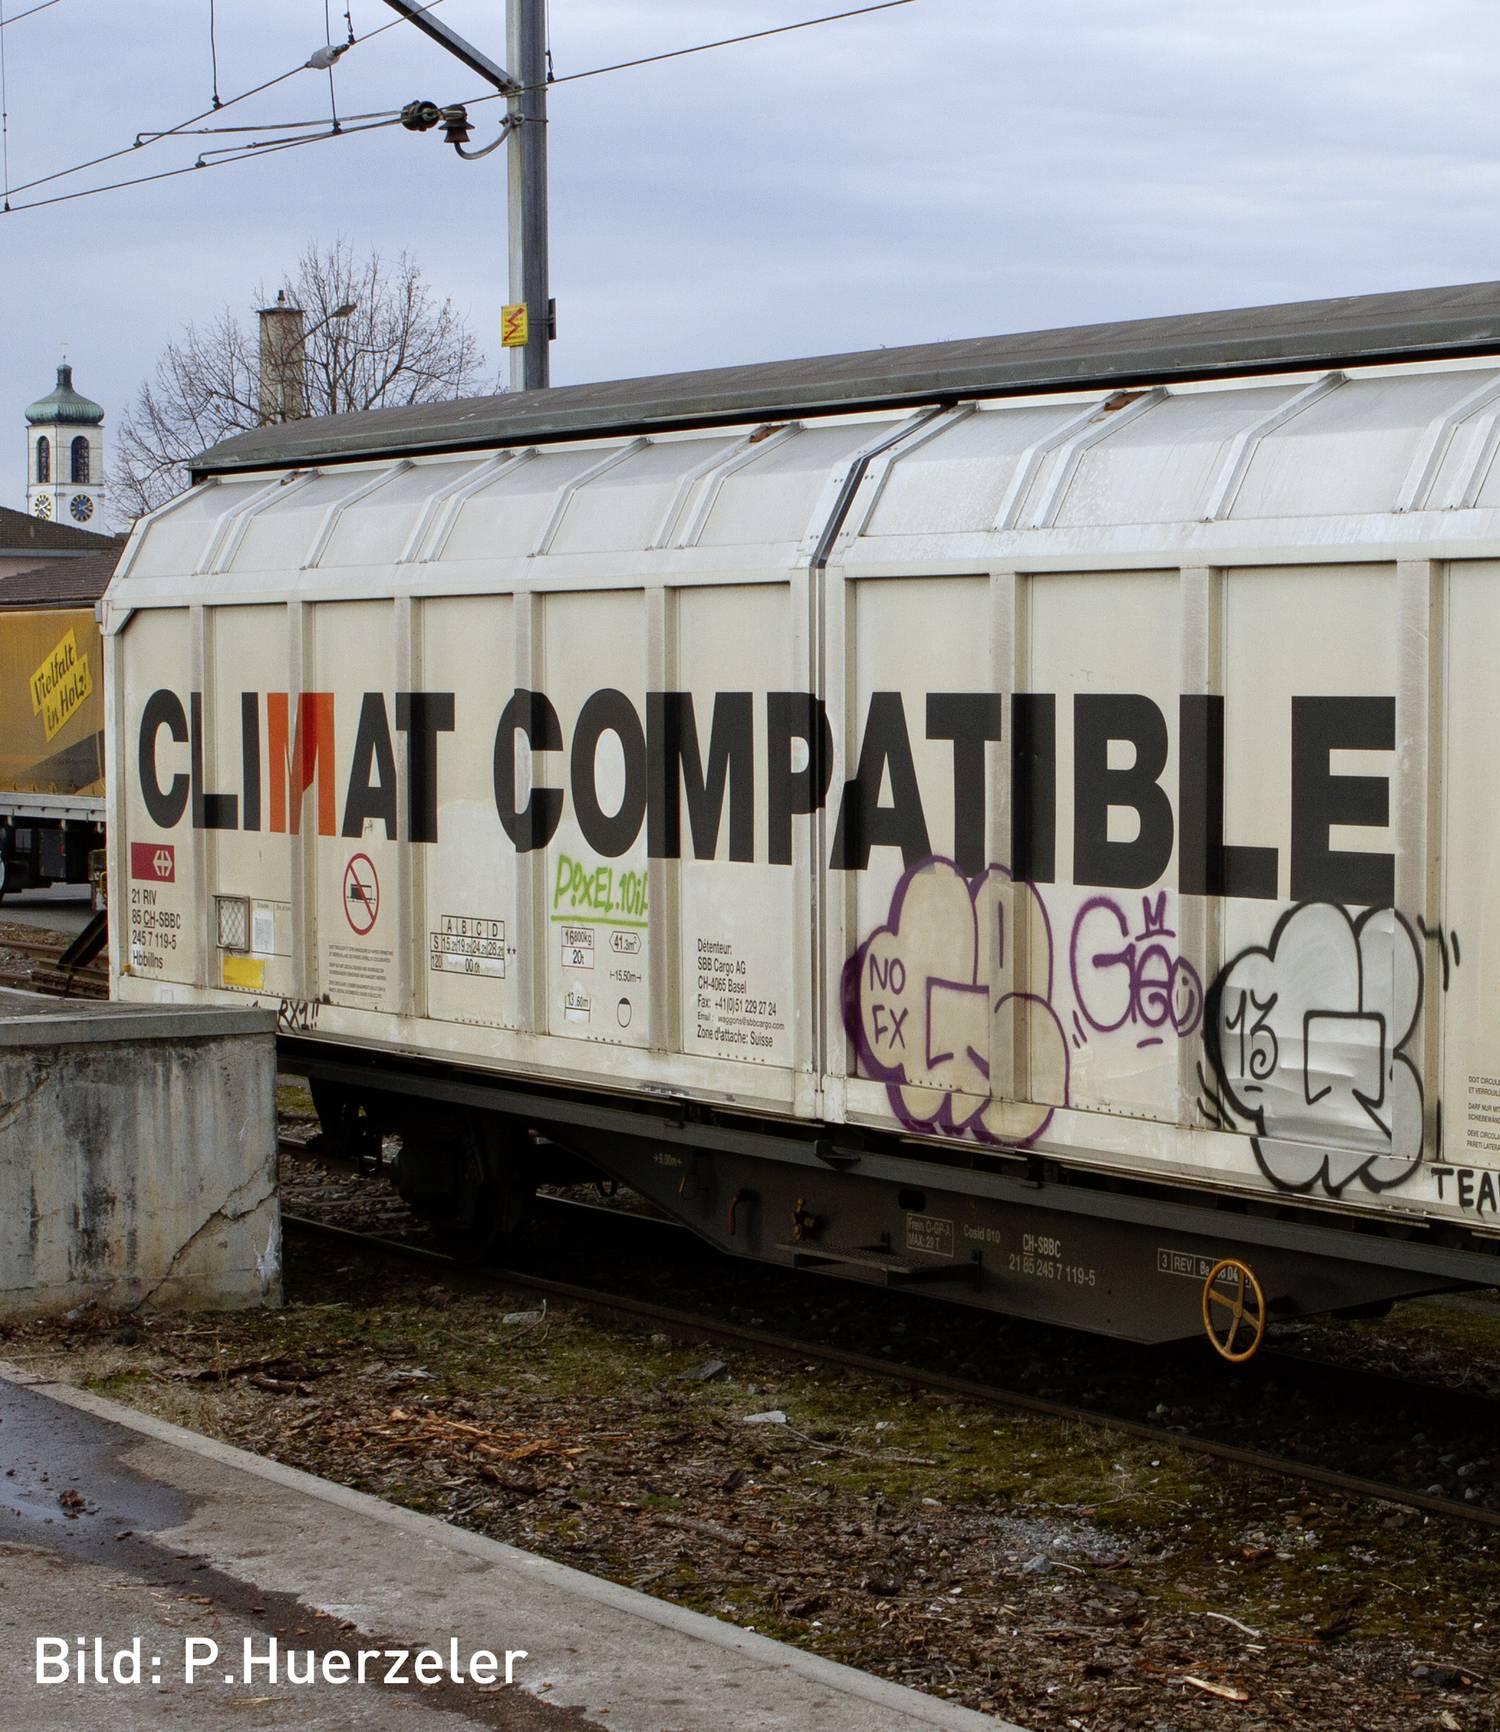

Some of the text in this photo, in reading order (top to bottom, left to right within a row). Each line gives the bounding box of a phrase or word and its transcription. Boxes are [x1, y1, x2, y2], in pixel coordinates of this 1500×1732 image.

[34, 643, 75, 706] Vielfalt
[47, 662, 87, 731] in Holz!
[139, 687, 1396, 906] CLIMAT COMPATIBLE
[131, 888, 157, 905] 21 RIV
[131, 908, 181, 930] 85 CH-SBBC
[446, 919, 498, 937] A B C D
[132, 929, 177, 950] 245 7 119-5
[433, 935, 440, 950] S
[431, 954, 443, 969] 120
[697, 956, 746, 977] SBB Cargo AG
[697, 975, 747, 994] CH-4065 Basel
[869, 953, 907, 995] NO
[697, 993, 712, 1009] Fax:
[744, 999, 757, 1015] 229
[758, 1000, 767, 1015] 27
[768, 1001, 777, 1016] 24
[697, 1024, 714, 1040] Zone
[750, 1030, 774, 1048] Suisse
[871, 1004, 909, 1049] FX
[1022, 1233, 1061, 1259] CH-SBBC
[1009, 1253, 1096, 1287] 21 85 245 7 119-5
[1161, 1254, 1168, 1268] 3
[1173, 1256, 1193, 1272] REV
